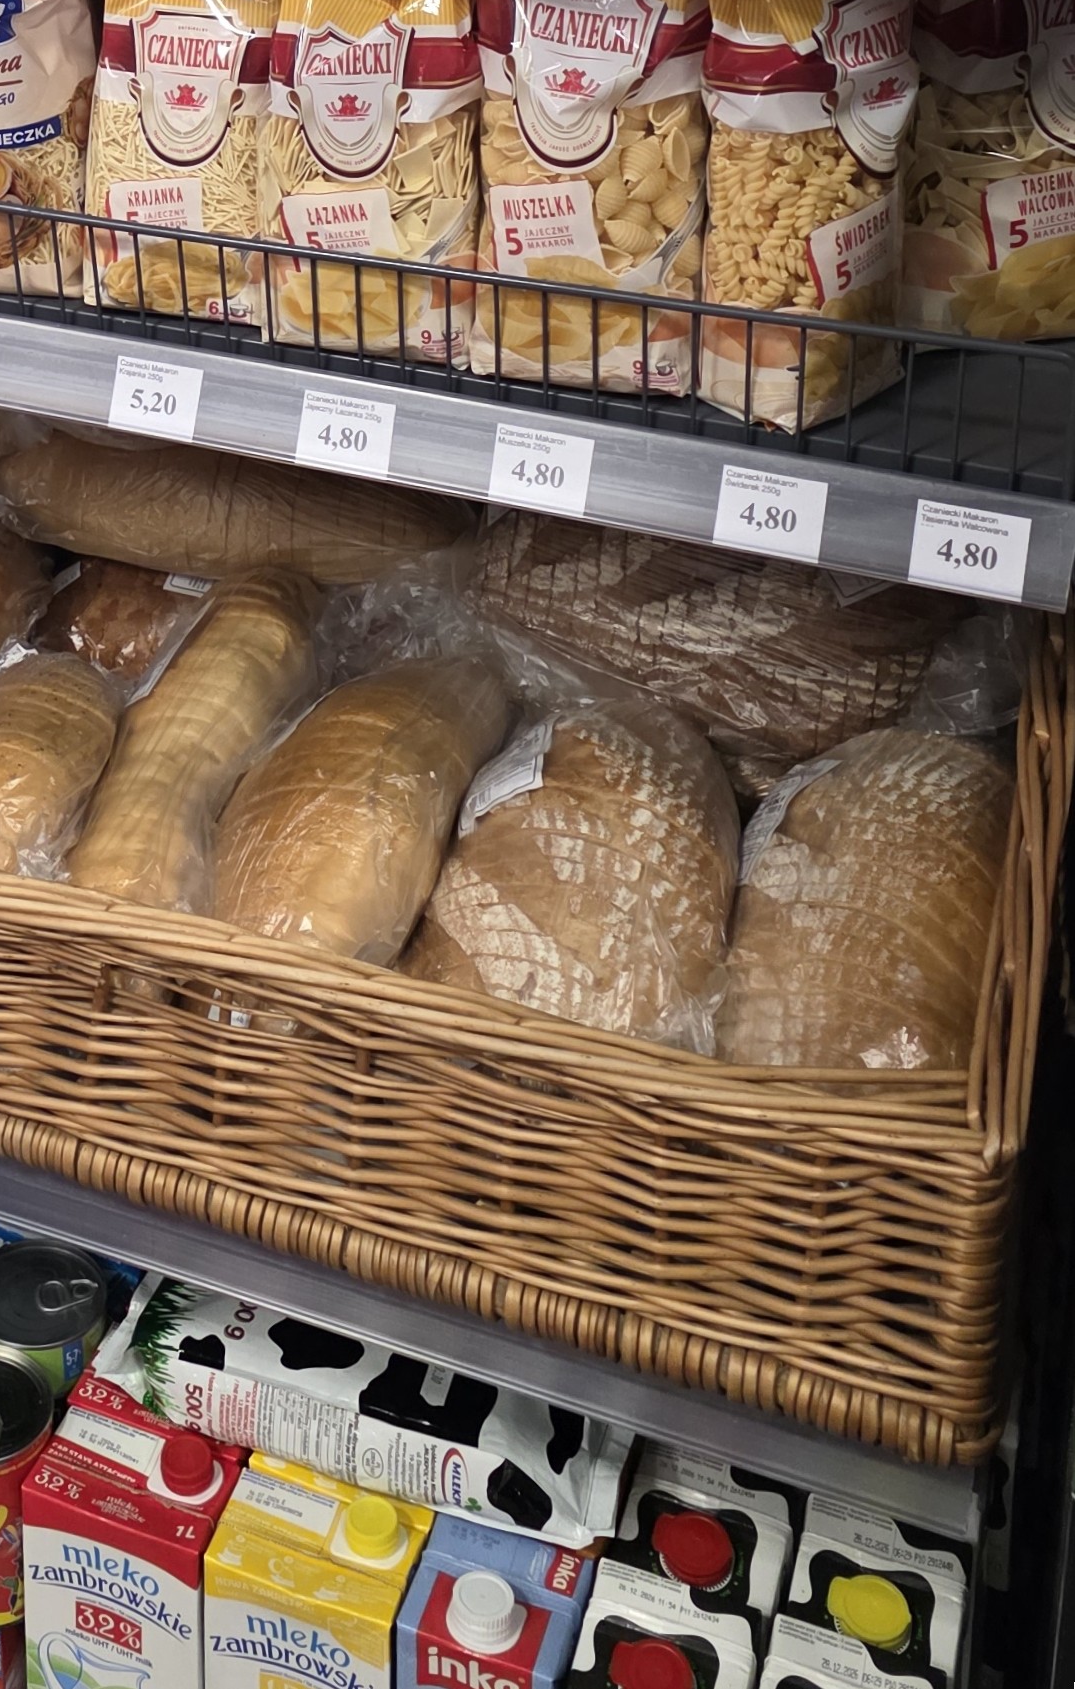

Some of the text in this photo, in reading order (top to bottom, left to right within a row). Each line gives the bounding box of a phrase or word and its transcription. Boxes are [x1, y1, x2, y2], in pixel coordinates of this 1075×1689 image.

[530, 1, 638, 55] CZANIECKI
[147, 34, 232, 71] CZANIECKI
[127, 187, 184, 205] KRAJANKA
[503, 193, 576, 219] MUSZELKA
[307, 202, 368, 226] ŁAZANKA
[505, 228, 524, 256] 5
[525, 226, 571, 238] JAJECZNY
[528, 237, 575, 250] MAKARON
[835, 208, 891, 256] ŚWIDEREK
[836, 259, 852, 291] 5
[130, 389, 177, 416] 5,20
[318, 424, 368, 452] 4,80
[511, 459, 565, 489] 4,80
[740, 502, 797, 532] 4,80
[937, 539, 998, 570] 4,80
[184, 1383, 204, 1412] 500
[62, 1544, 159, 1596] mleko
[552, 1553, 576, 1590] inka
[29, 1564, 192, 1641] zambrowskie
[247, 1615, 351, 1668] mleko
